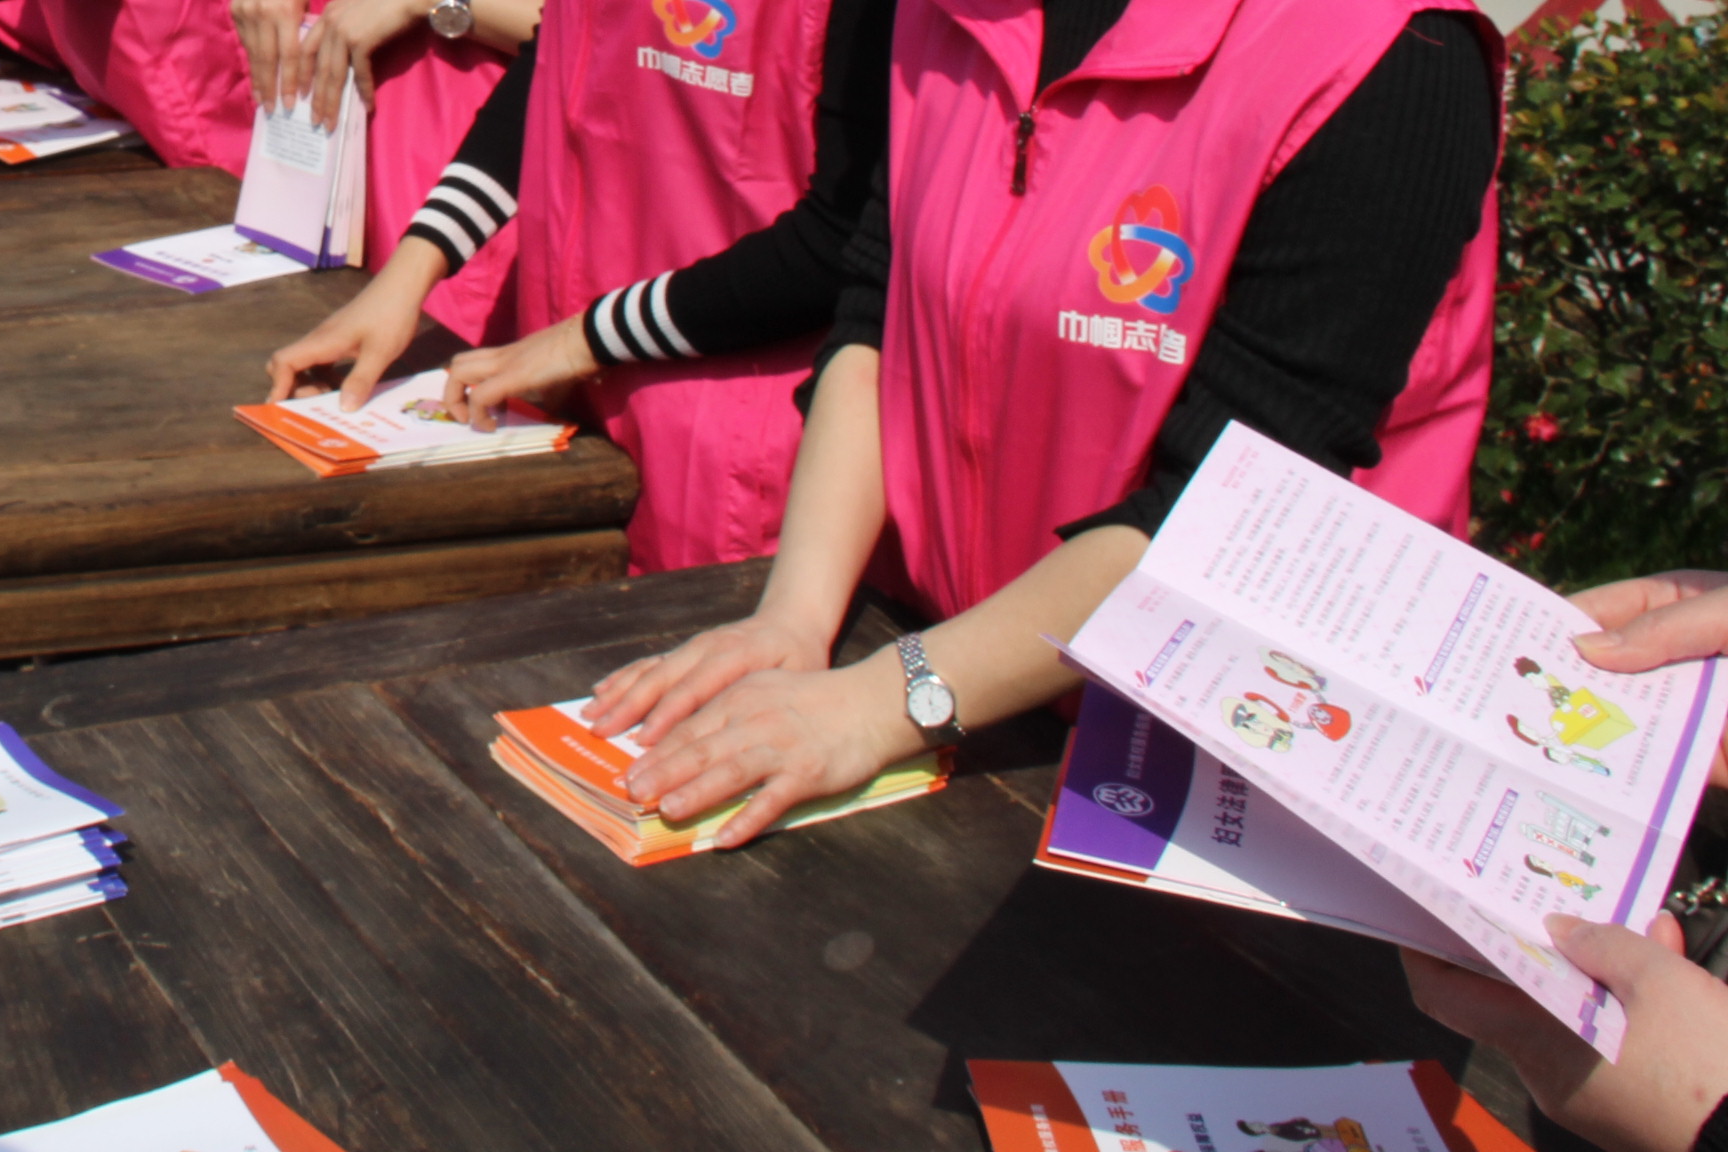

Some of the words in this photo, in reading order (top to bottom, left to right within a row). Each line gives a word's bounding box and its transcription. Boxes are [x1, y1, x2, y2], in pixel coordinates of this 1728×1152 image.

[636, 46, 754, 98] 巾帼志愿者
[1058, 309, 1187, 365] 巾帼志者
